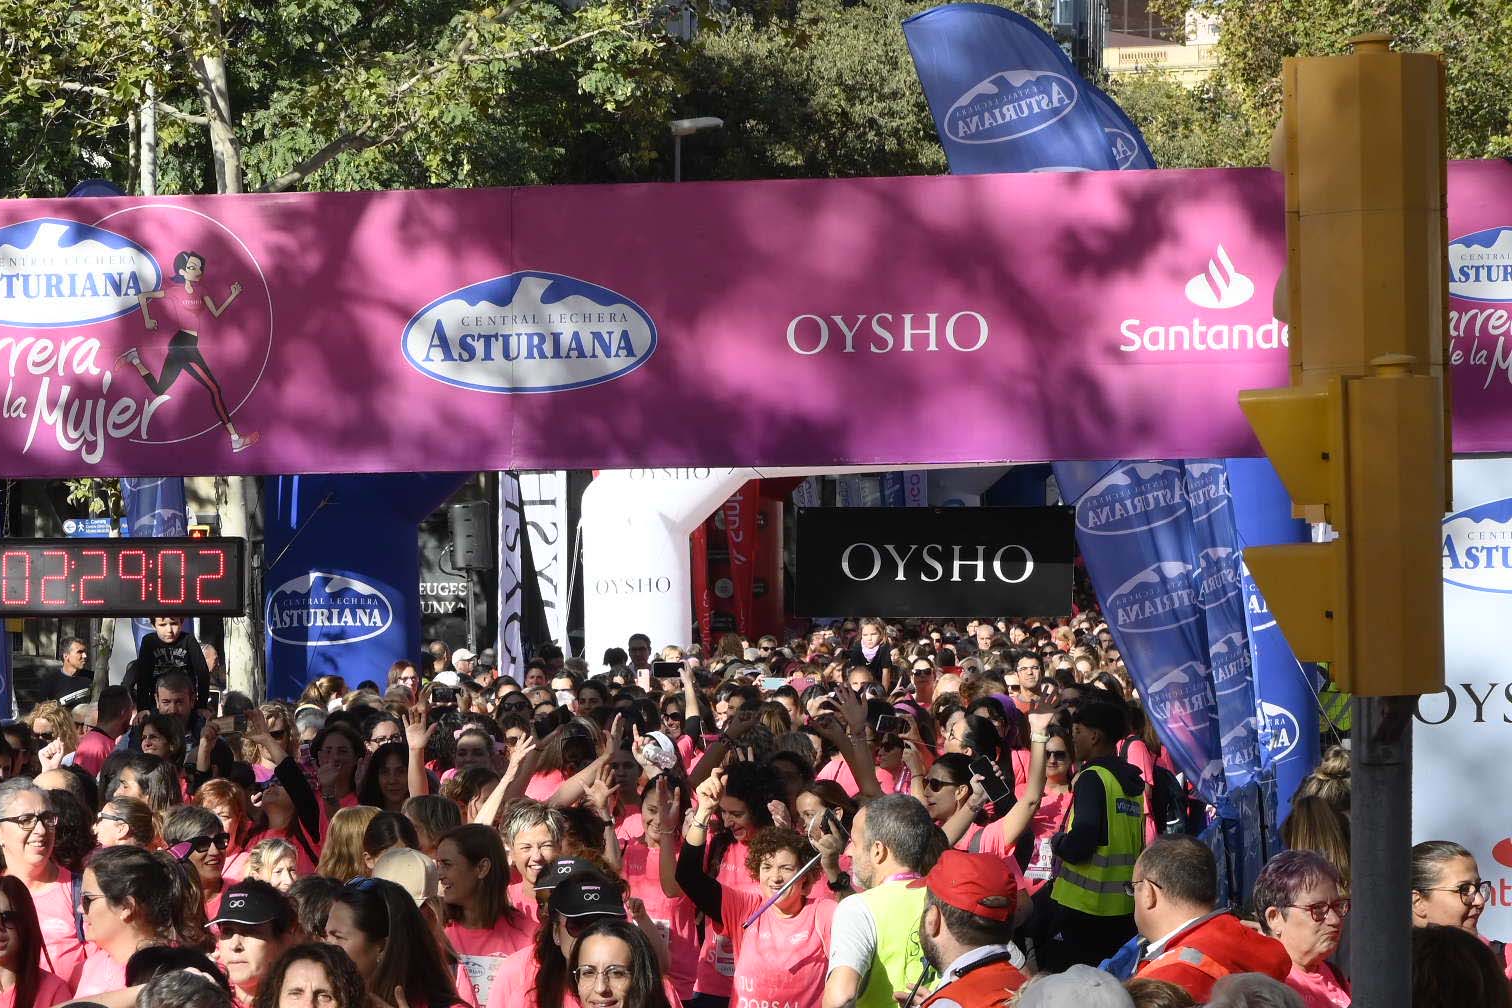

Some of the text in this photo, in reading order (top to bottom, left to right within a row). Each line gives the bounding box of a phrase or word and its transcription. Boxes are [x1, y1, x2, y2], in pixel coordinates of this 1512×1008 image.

[461, 312, 629, 326] CENTRAL LECHERA
[787, 311, 989, 355] OYSHO
[1120, 318, 1288, 352] Santande
[423, 318, 638, 363] ASTURIANA
[2, 378, 27, 418] la
[22, 370, 172, 464] Mujer
[0, 550, 225, 605] 02:29:02
[841, 542, 1034, 583] OYSHO
[419, 582, 467, 596] EUGES
[596, 576, 671, 594] OYSHO
[271, 600, 383, 628] ASTURIANA
